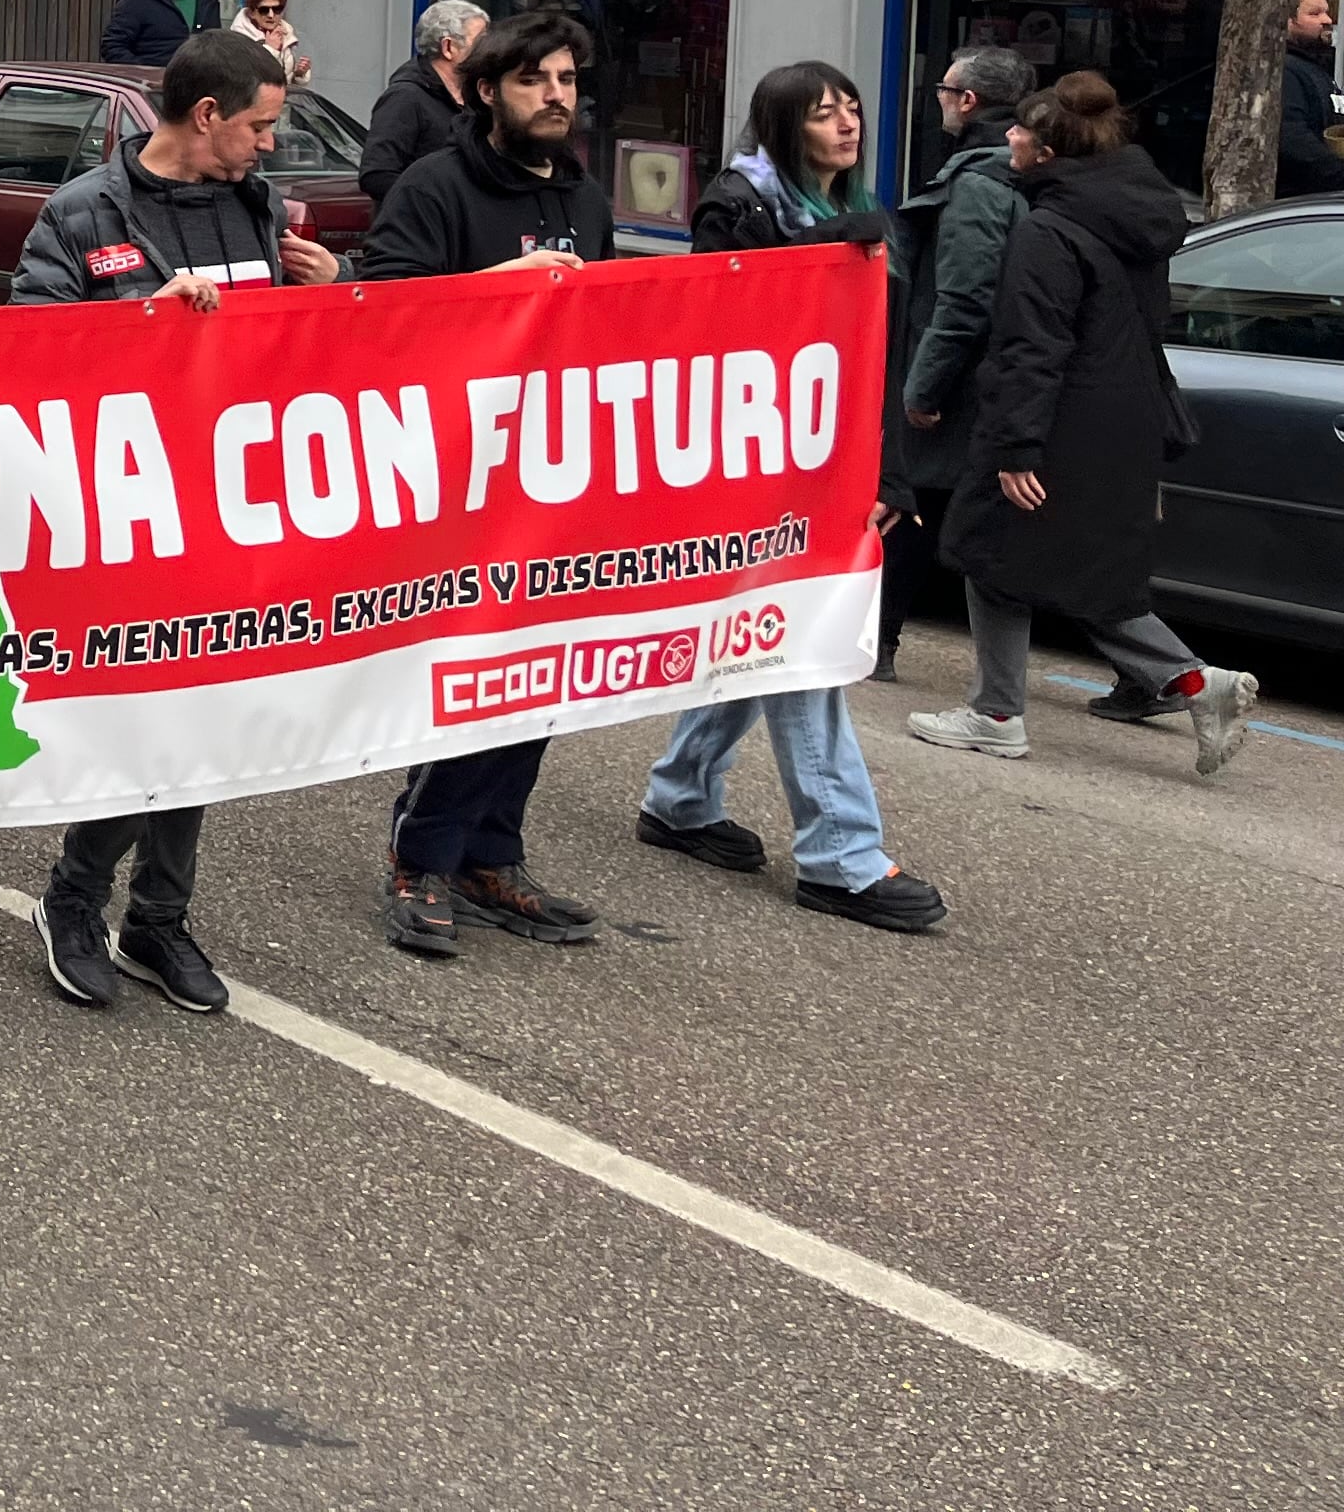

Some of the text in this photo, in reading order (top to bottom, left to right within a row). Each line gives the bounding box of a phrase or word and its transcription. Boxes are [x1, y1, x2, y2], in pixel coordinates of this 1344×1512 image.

[213, 384, 440, 547] CON
[464, 341, 840, 513] FUTURO
[84, 599, 322, 667] MENTIRAS,
[331, 563, 481, 636] EXCUSAS
[489, 561, 518, 603] Y
[526, 512, 809, 600] DISCRIMINACIÓN
[442, 603, 786, 713] CCOO UGT USO
